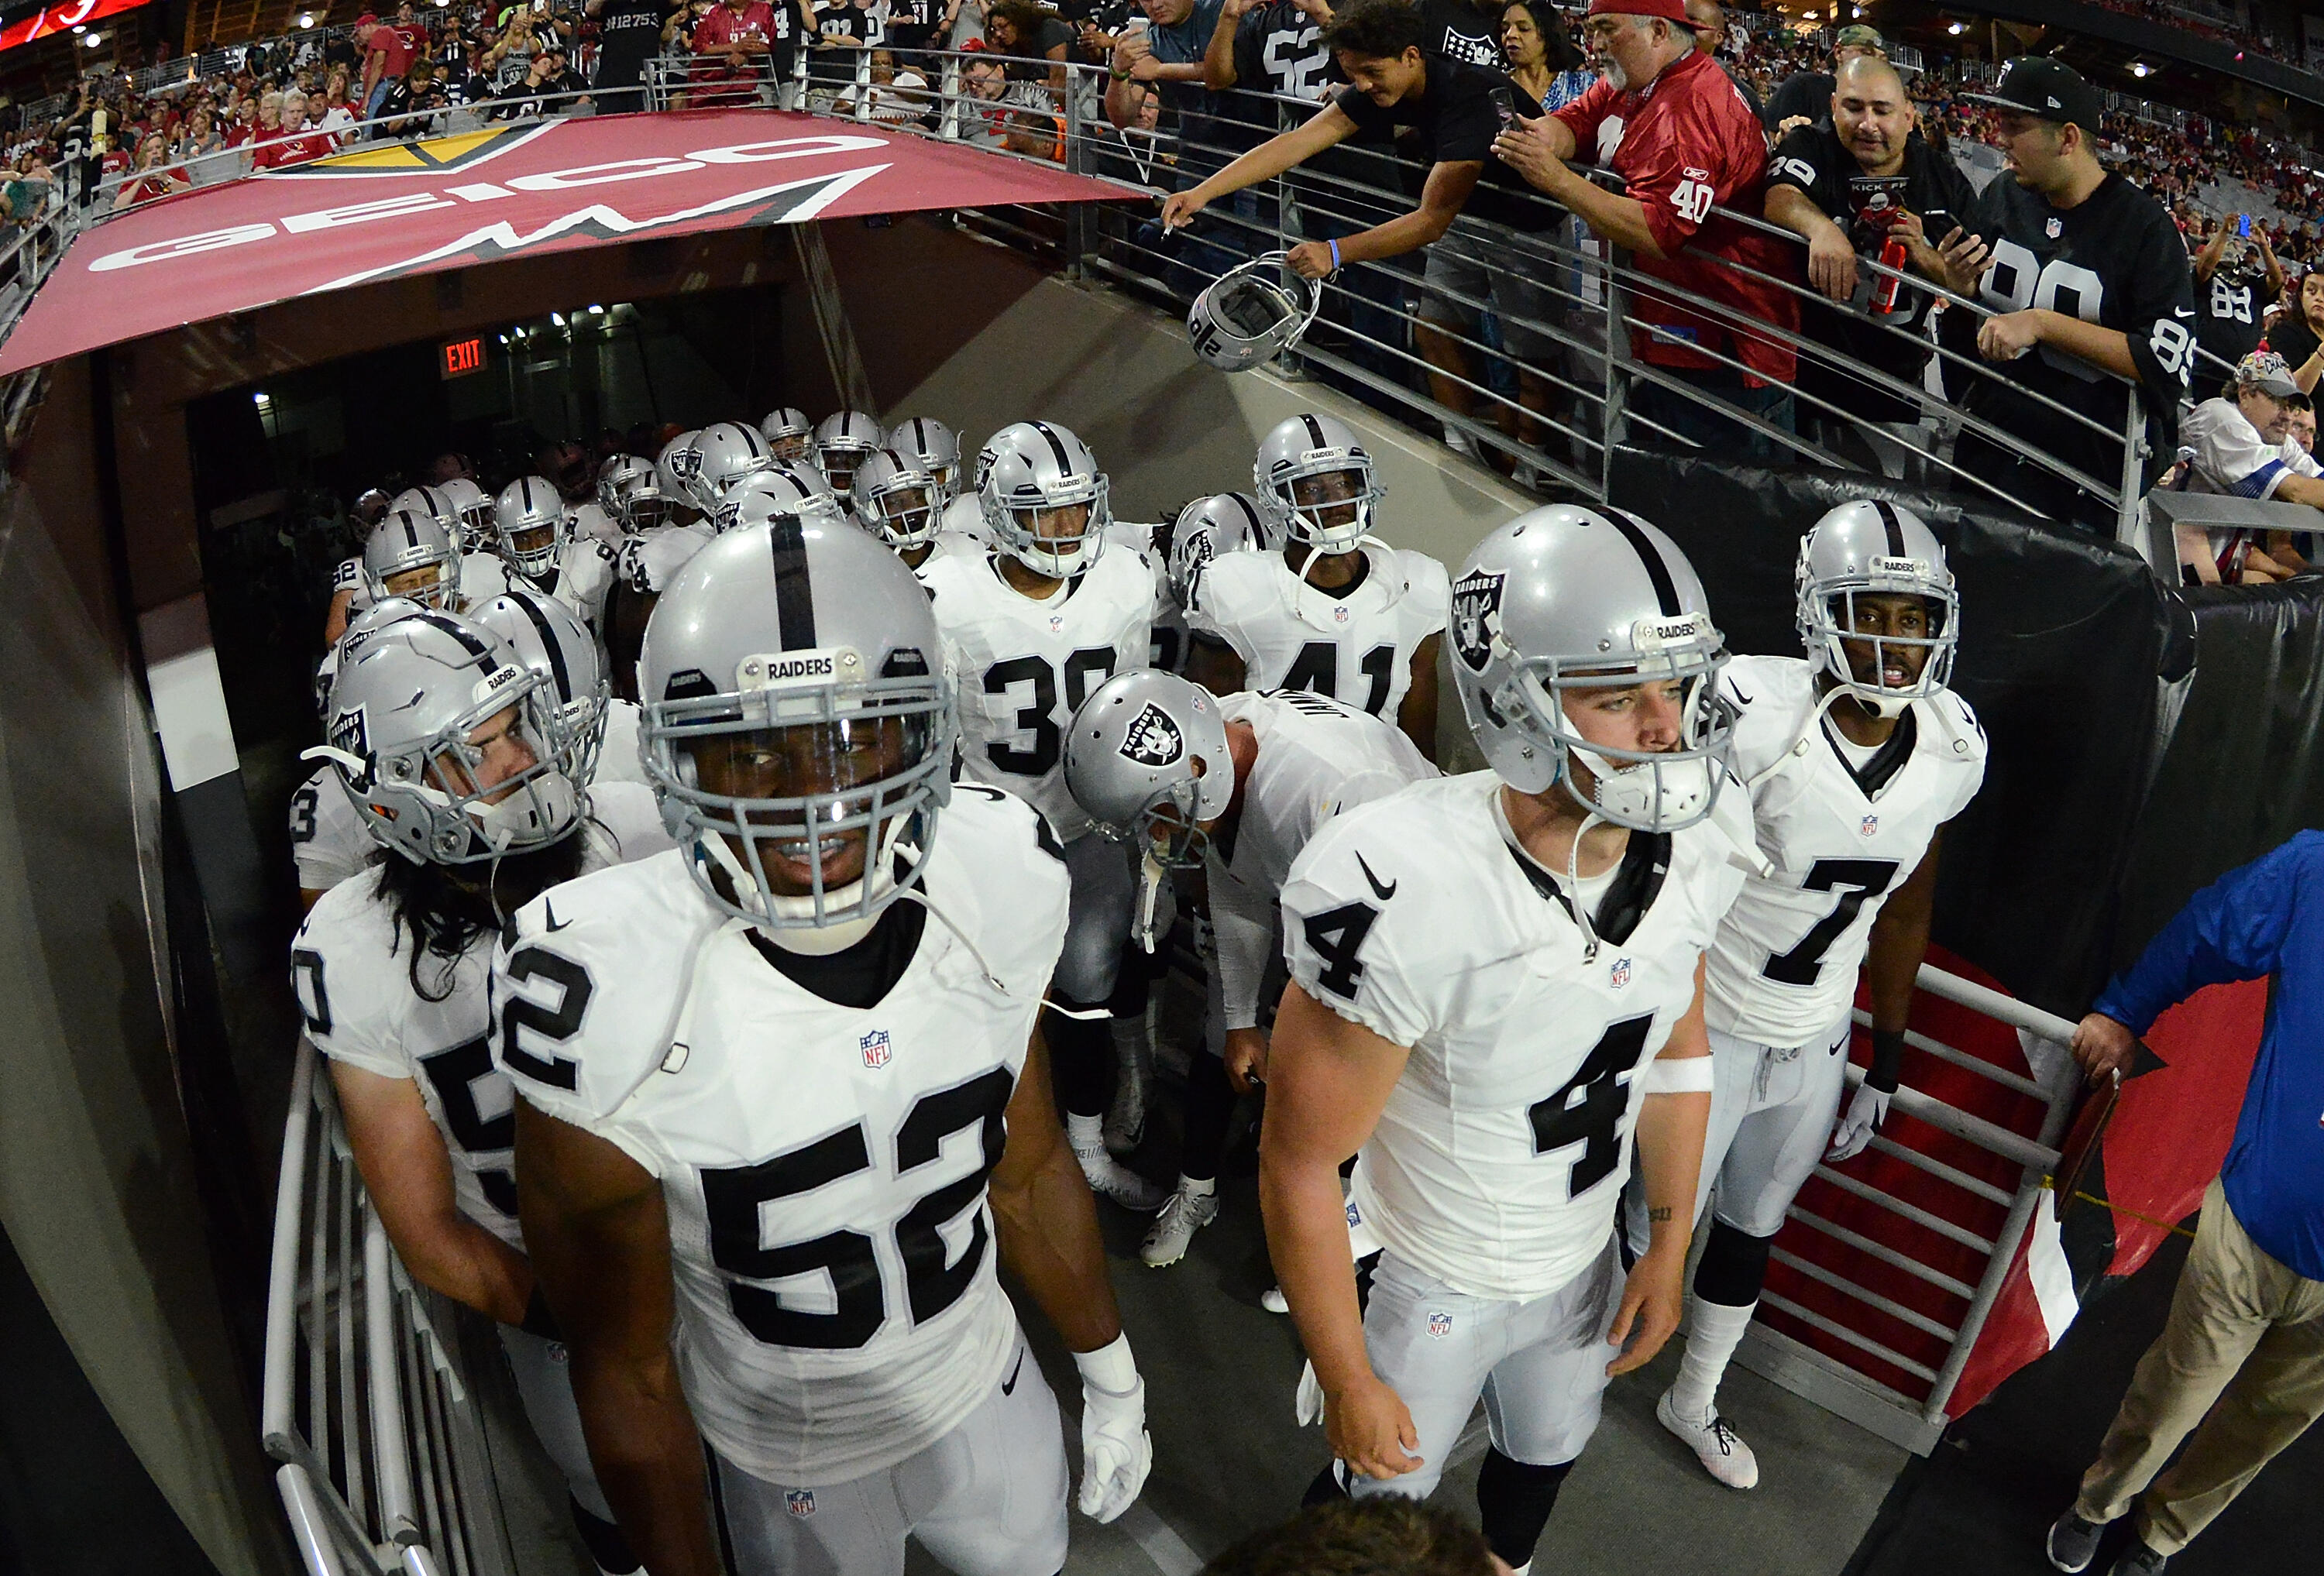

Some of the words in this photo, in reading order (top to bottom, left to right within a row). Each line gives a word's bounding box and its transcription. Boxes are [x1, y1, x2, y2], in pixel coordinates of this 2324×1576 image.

[1263, 26, 1331, 101] 52
[89, 136, 889, 272] GEICO
[1669, 180, 1714, 224] 40
[446, 339, 480, 372] EXIT
[1312, 450, 1335, 460] RAIDERS
[1058, 478, 1081, 489] RAIDERS
[1884, 561, 1915, 572] RAIDERS
[1455, 576, 1498, 594] RAIDERS
[1657, 623, 1696, 640] RAIDERS
[487, 668, 517, 692] RAIDERS
[768, 658, 833, 680] RAIDERS
[1279, 639, 1397, 717] 41
[1124, 707, 1153, 752] RAIDERS
[1759, 856, 1905, 987] 7
[1302, 898, 1384, 1004] 4
[1612, 970, 1629, 985] NFL
[865, 1044, 889, 1065] NFL
[1525, 1008, 1659, 1203] 4
[699, 1061, 1018, 1354] 52
[1430, 1323, 1448, 1335] NFL
[790, 1499, 816, 1515] NFL
